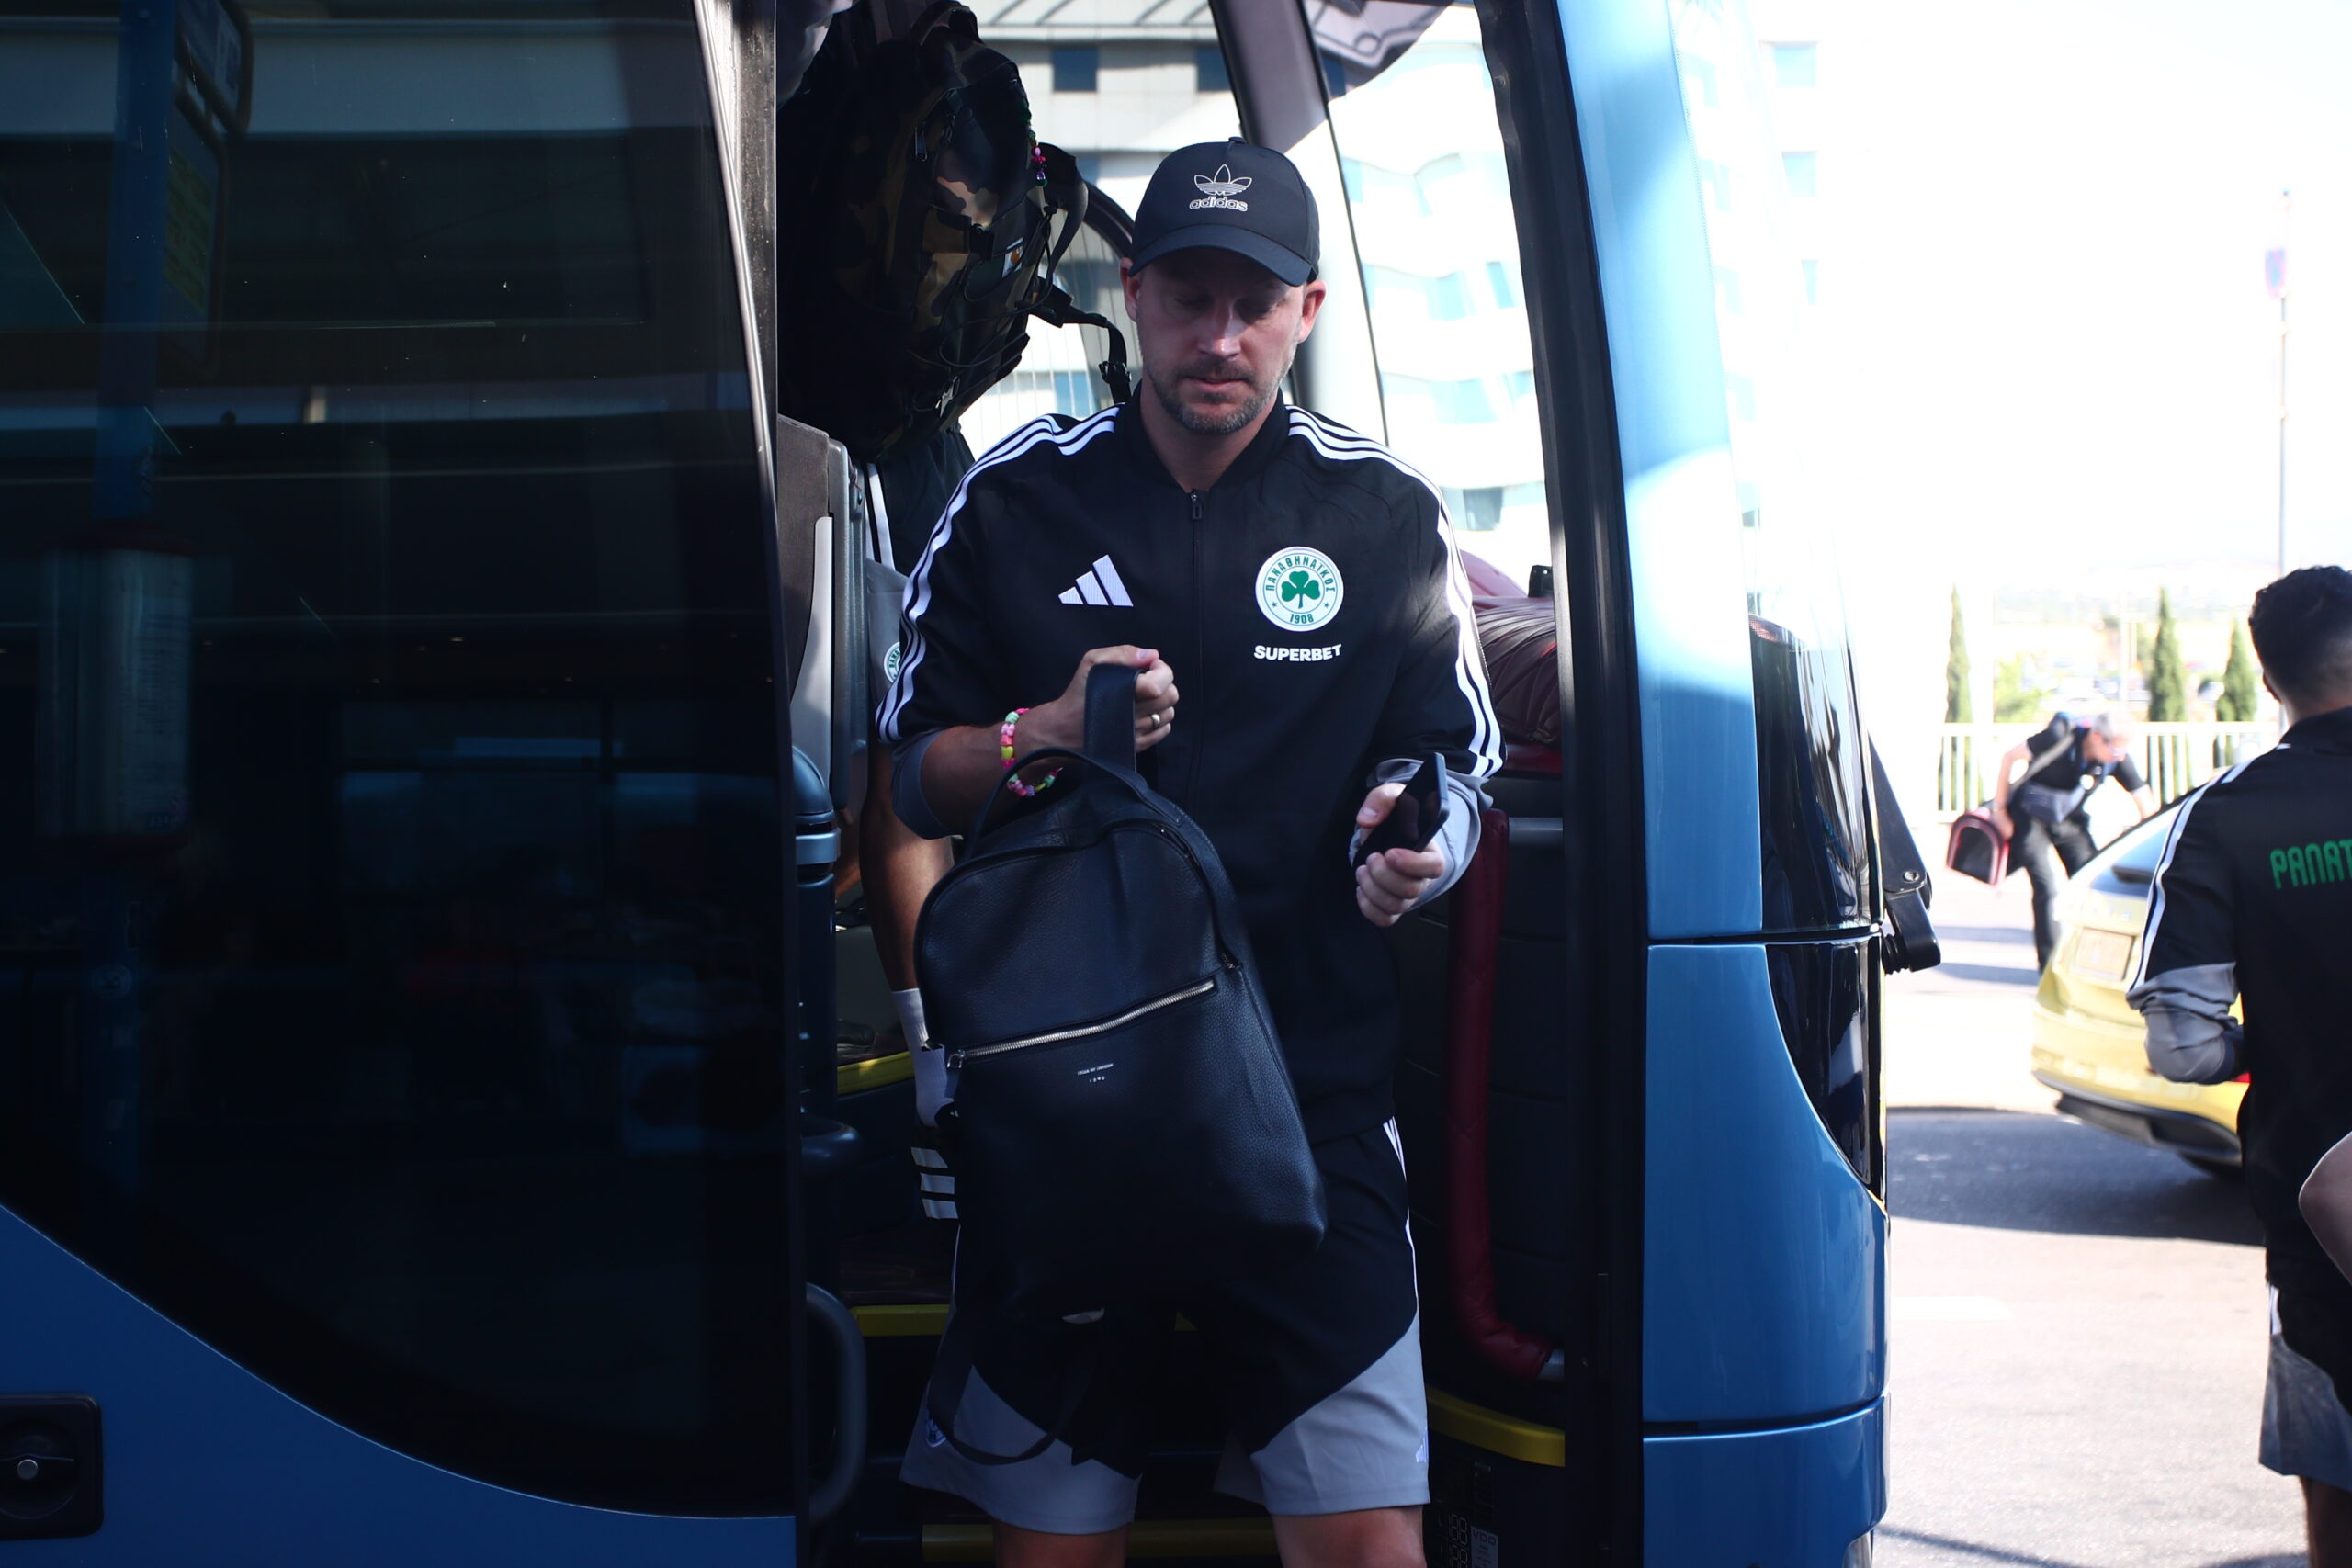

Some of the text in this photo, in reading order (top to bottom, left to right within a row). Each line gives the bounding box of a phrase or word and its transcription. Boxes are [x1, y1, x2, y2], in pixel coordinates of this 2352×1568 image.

[1189, 196, 1248, 211] adidas
[1289, 614, 1314, 624] 1908
[1253, 644, 1342, 662] SUPERBET
[2270, 839, 2352, 889] PANAT
